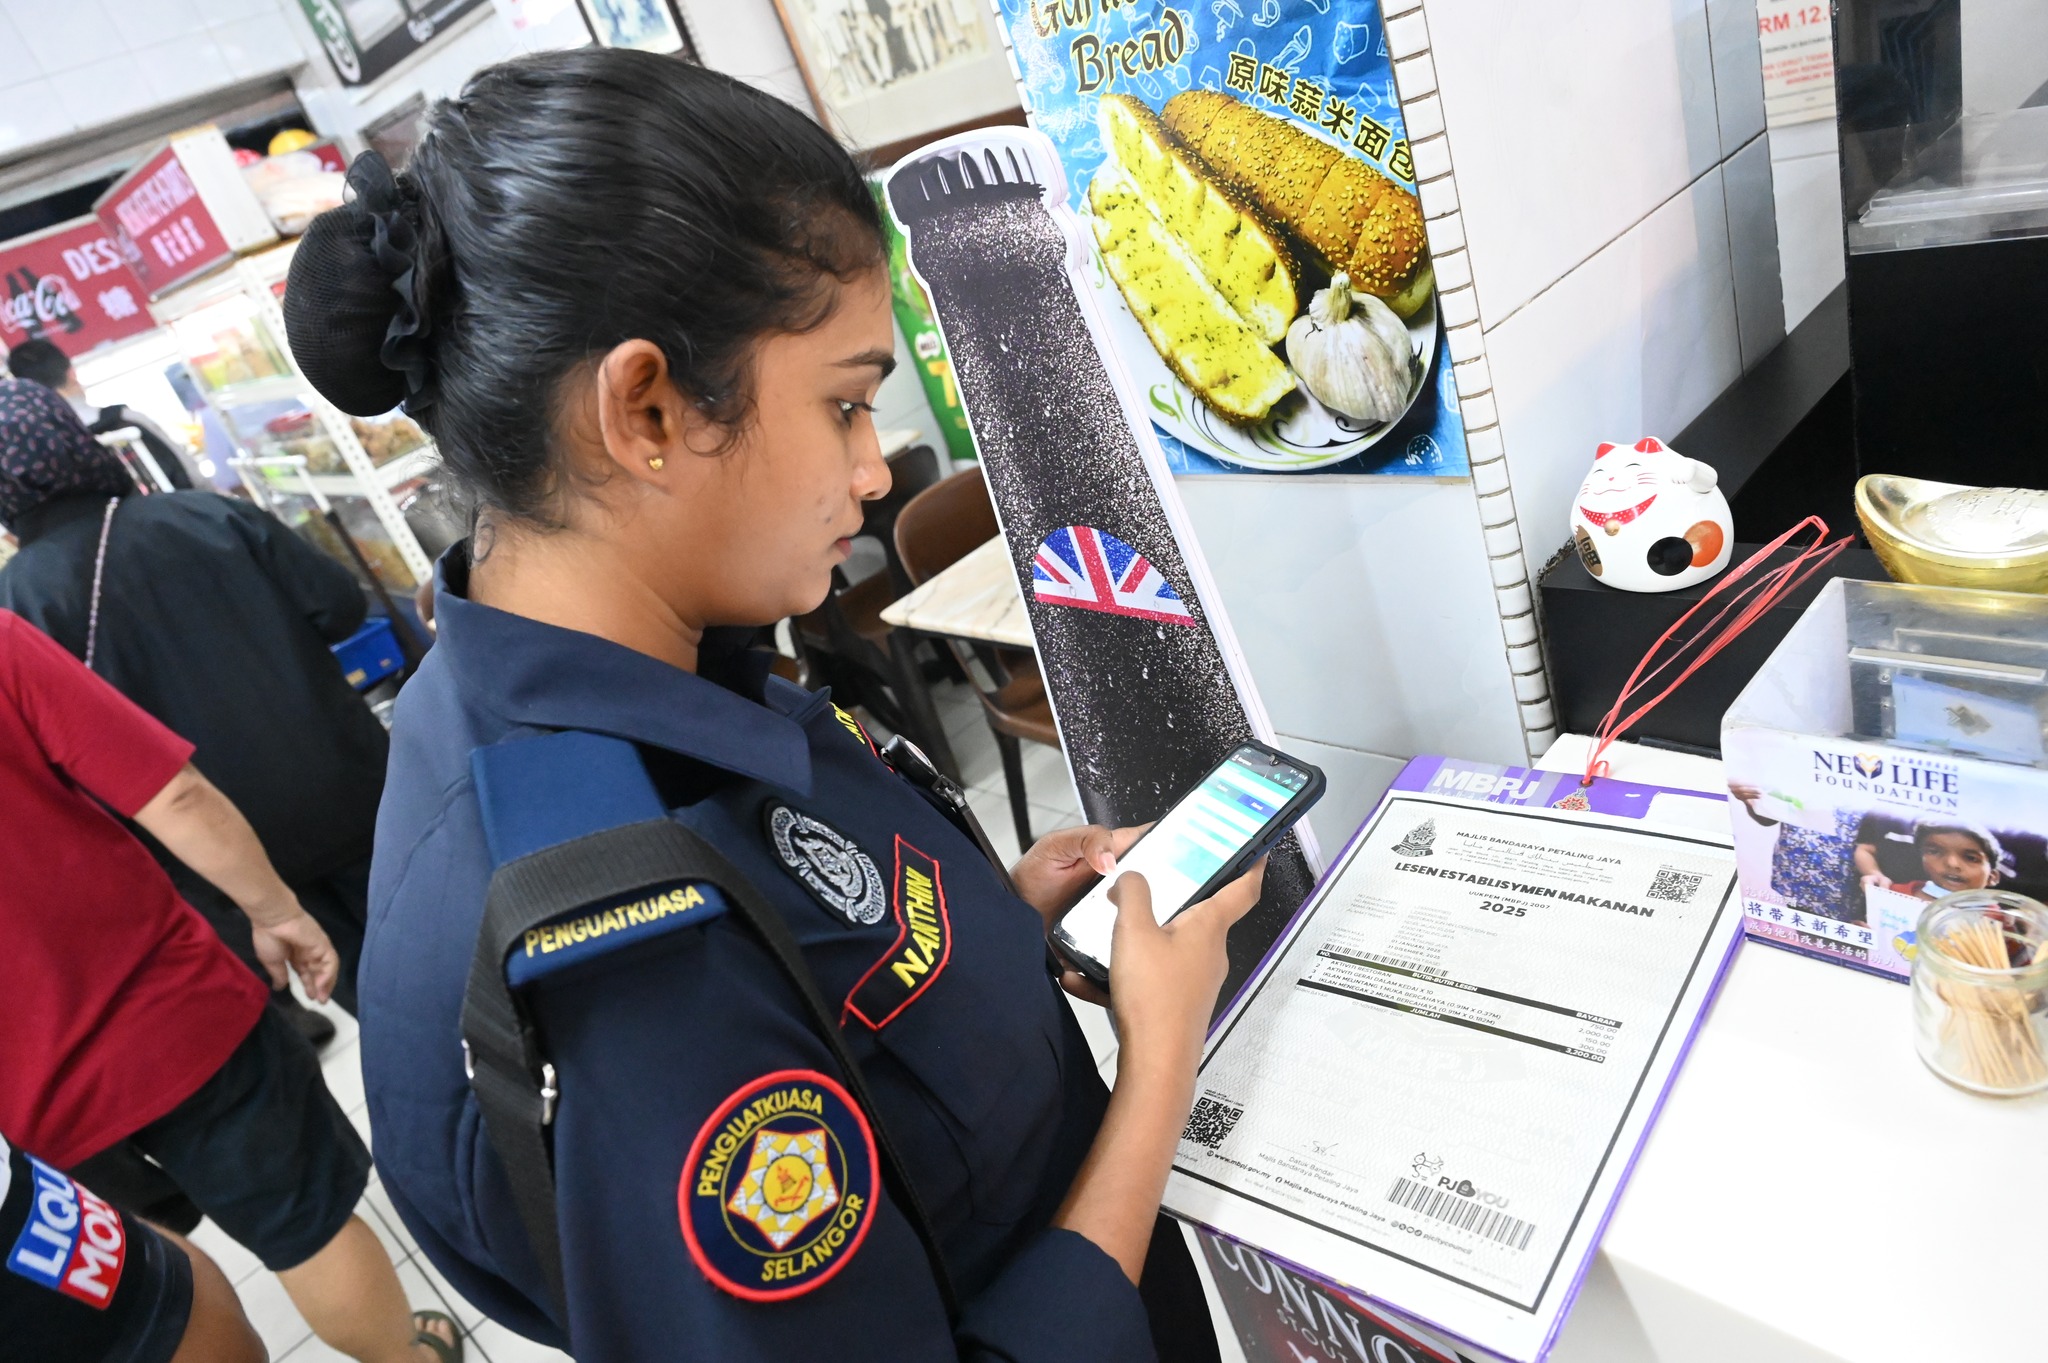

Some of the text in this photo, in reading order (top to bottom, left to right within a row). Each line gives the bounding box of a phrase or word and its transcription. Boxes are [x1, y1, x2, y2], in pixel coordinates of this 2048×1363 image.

[1031, 0, 1137, 37] Gar
[1759, 5, 1832, 34] RM 12.
[1072, 9, 1184, 93] Bread
[1227, 53, 1415, 182] 原味蒜米面包
[62, 238, 122, 282] DES
[1433, 769, 1540, 800] MBPJ
[1815, 774, 1957, 808] FOUNDATION
[1892, 765, 1959, 794] LIFE
[1456, 831, 1622, 865] MAJLIS BANDARAYA PETALING JAYA
[1395, 862, 1439, 877] LESEN
[1439, 870, 1558, 898] ESTABLISYMEN
[1558, 891, 1654, 917] MAKANAN
[1468, 891, 1500, 902] UUKPEM
[1502, 898, 1529, 907] (MBPJ)
[524, 885, 705, 957] PENGUATKUASA
[1479, 901, 1528, 917] 2025
[891, 866, 933, 989] NANTHINI
[1326, 966, 1353, 976] AKTIVITI
[1354, 972, 1372, 981] GERAI
[1373, 976, 1397, 987] DALAM
[1398, 983, 1418, 992] KEDAI
[1331, 960, 1357, 970] AKTIVITI
[1357, 966, 1392, 978] RESTORAN
[1412, 972, 1478, 992] BUTIR-BUTIR LESEN
[1319, 977, 1338, 988] IKLAN
[1339, 982, 1369, 995] MENEGAK
[1376, 992, 1395, 1000] MUKA
[1396, 996, 1438, 1011] BERCAHAYA
[1468, 1013, 1495, 1025] 0.182M)
[1323, 972, 1342, 982] IKLAN
[1342, 976, 1378, 989] MELINTANG
[1384, 987, 1403, 995] MUKA
[1404, 991, 1446, 1005] BERCAHAYA
[1446, 1001, 1470, 1012] (0.91M
[1477, 1008, 1501, 1020] 0.37M)
[1410, 1006, 1604, 1062] JUMLAH 3,200.00
[1576, 1012, 1616, 1026] BAYARAN
[1585, 1037, 1611, 1048] 150.00
[697, 1088, 823, 1196] PENGUATKUASA
[1214, 1153, 1272, 1179] www.mbpj.gov.my
[1258, 1152, 1359, 1194] Majlis Bandaraya Petaling Jaya
[1288, 1156, 1335, 1177] Datuk Bandar
[1284, 1180, 1302, 1193] Majlis
[1303, 1187, 1338, 1205] Bandaraya
[1339, 1201, 1368, 1216] Petaling
[1369, 1212, 1386, 1222] Jaya
[1438, 1176, 1510, 1209] PJ YOU
[16, 1158, 79, 1278] LIQU
[761, 1194, 864, 1282] SELANGOR
[1423, 1233, 1472, 1255] pjcitycouncil
